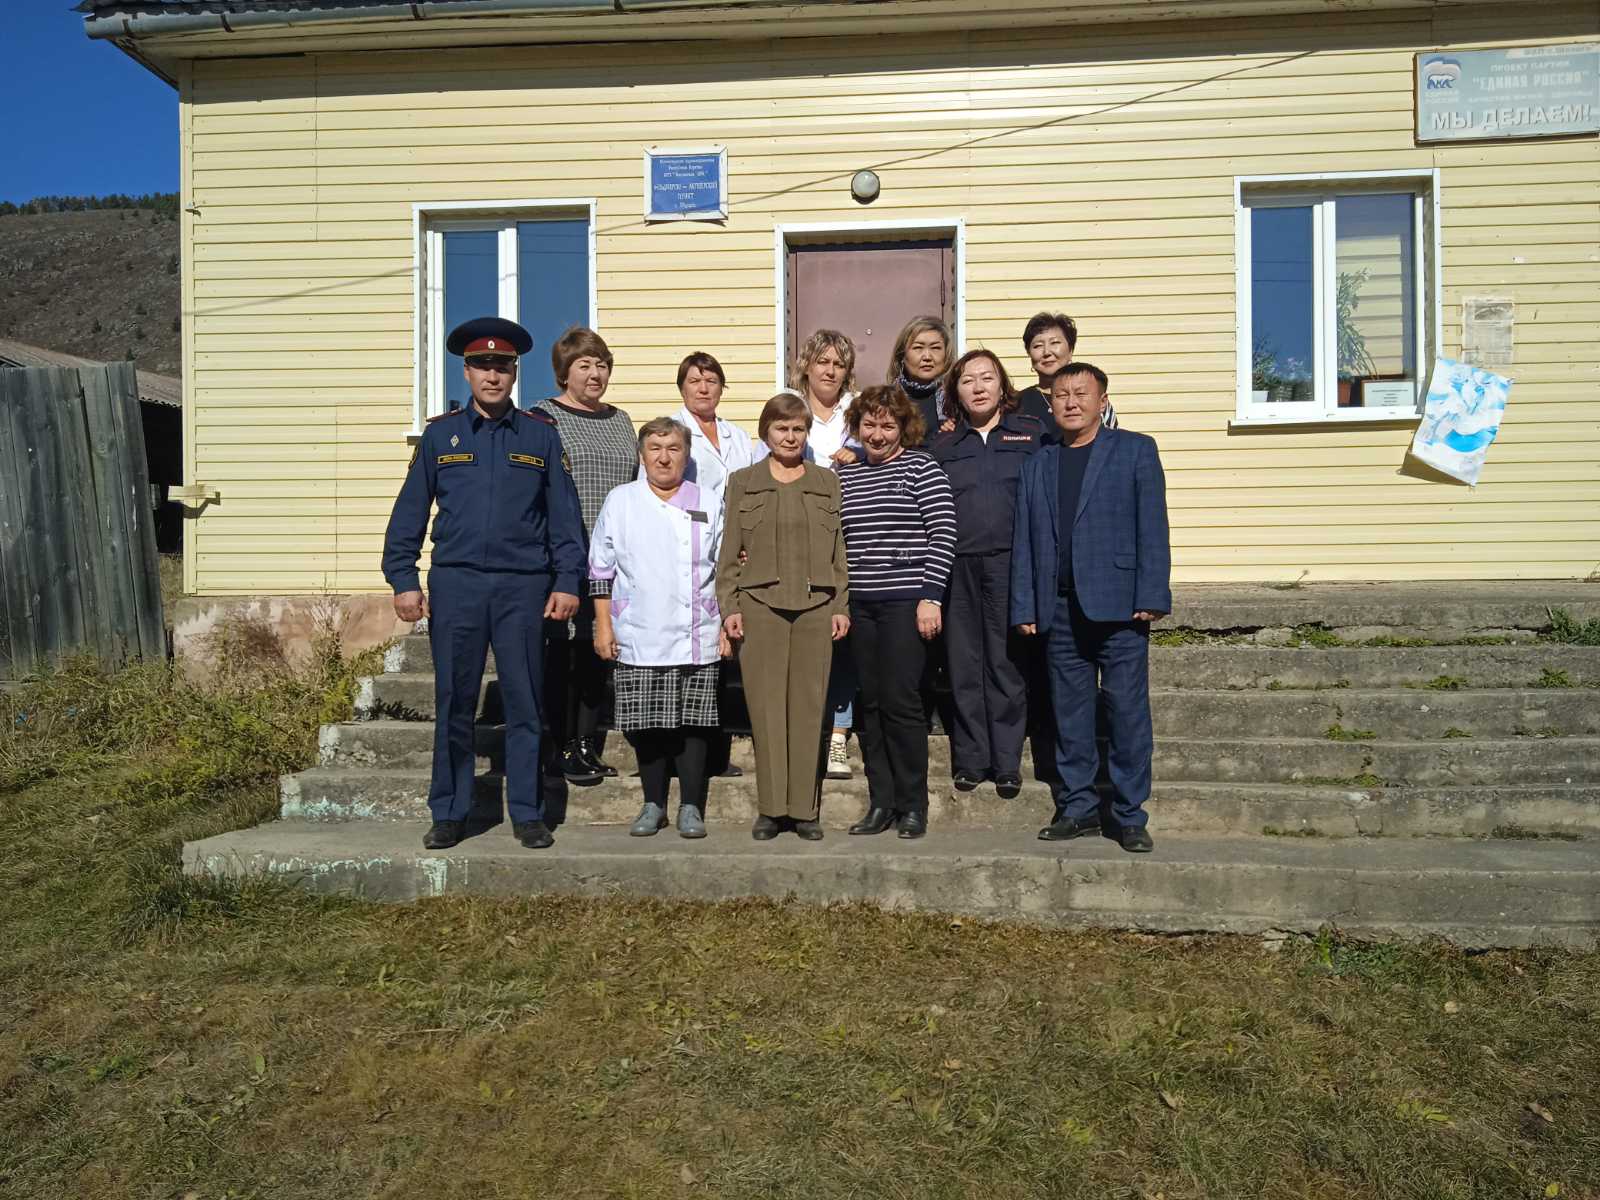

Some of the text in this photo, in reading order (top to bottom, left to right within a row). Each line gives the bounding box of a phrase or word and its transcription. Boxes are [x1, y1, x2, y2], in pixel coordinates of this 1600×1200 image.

[1490, 63, 1528, 72] ПРОЕКТ
[1432, 103, 1592, 130] МЫ ДЕЛАЕМ!
